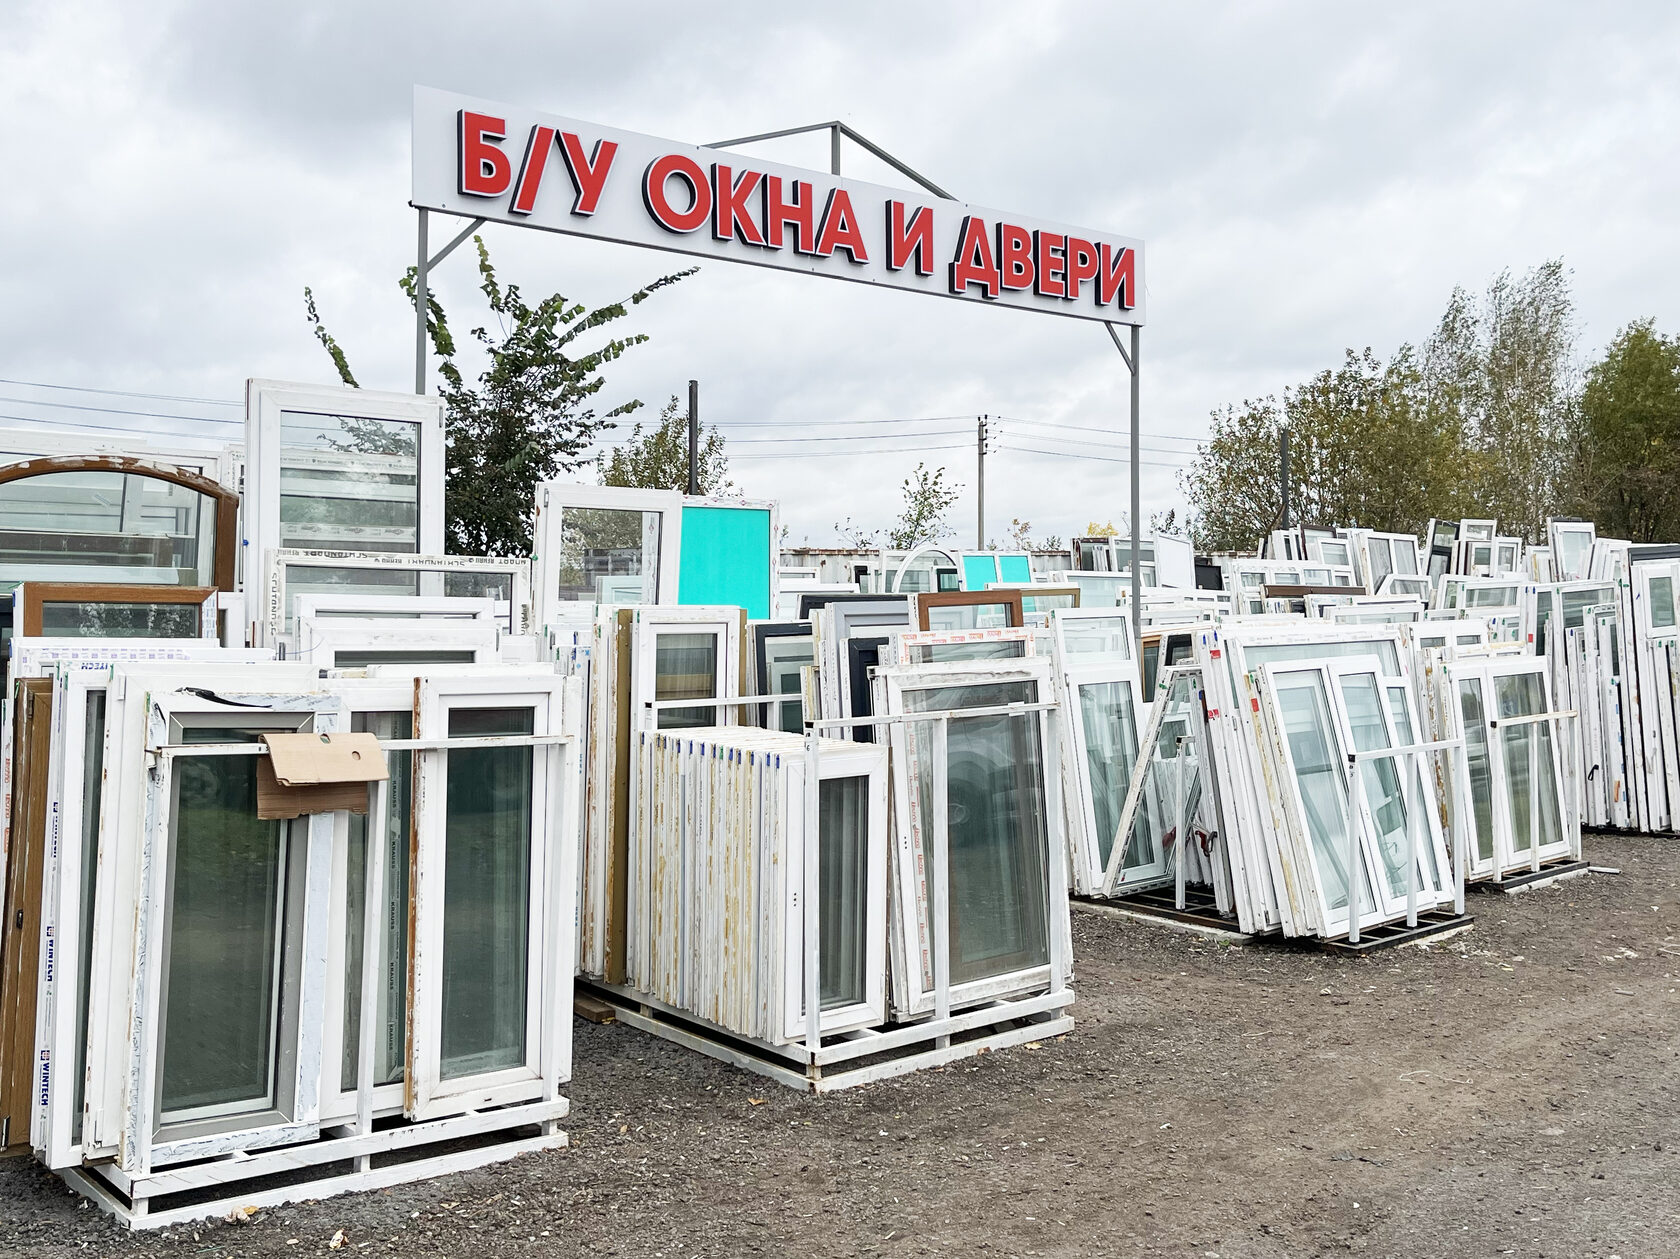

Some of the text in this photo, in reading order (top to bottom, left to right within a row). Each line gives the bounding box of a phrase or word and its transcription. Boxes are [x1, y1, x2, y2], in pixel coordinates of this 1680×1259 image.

[457, 109, 1136, 310] Б/У ОКНА И ДВЕРИ
[41, 1062, 50, 1106] WINTECH
